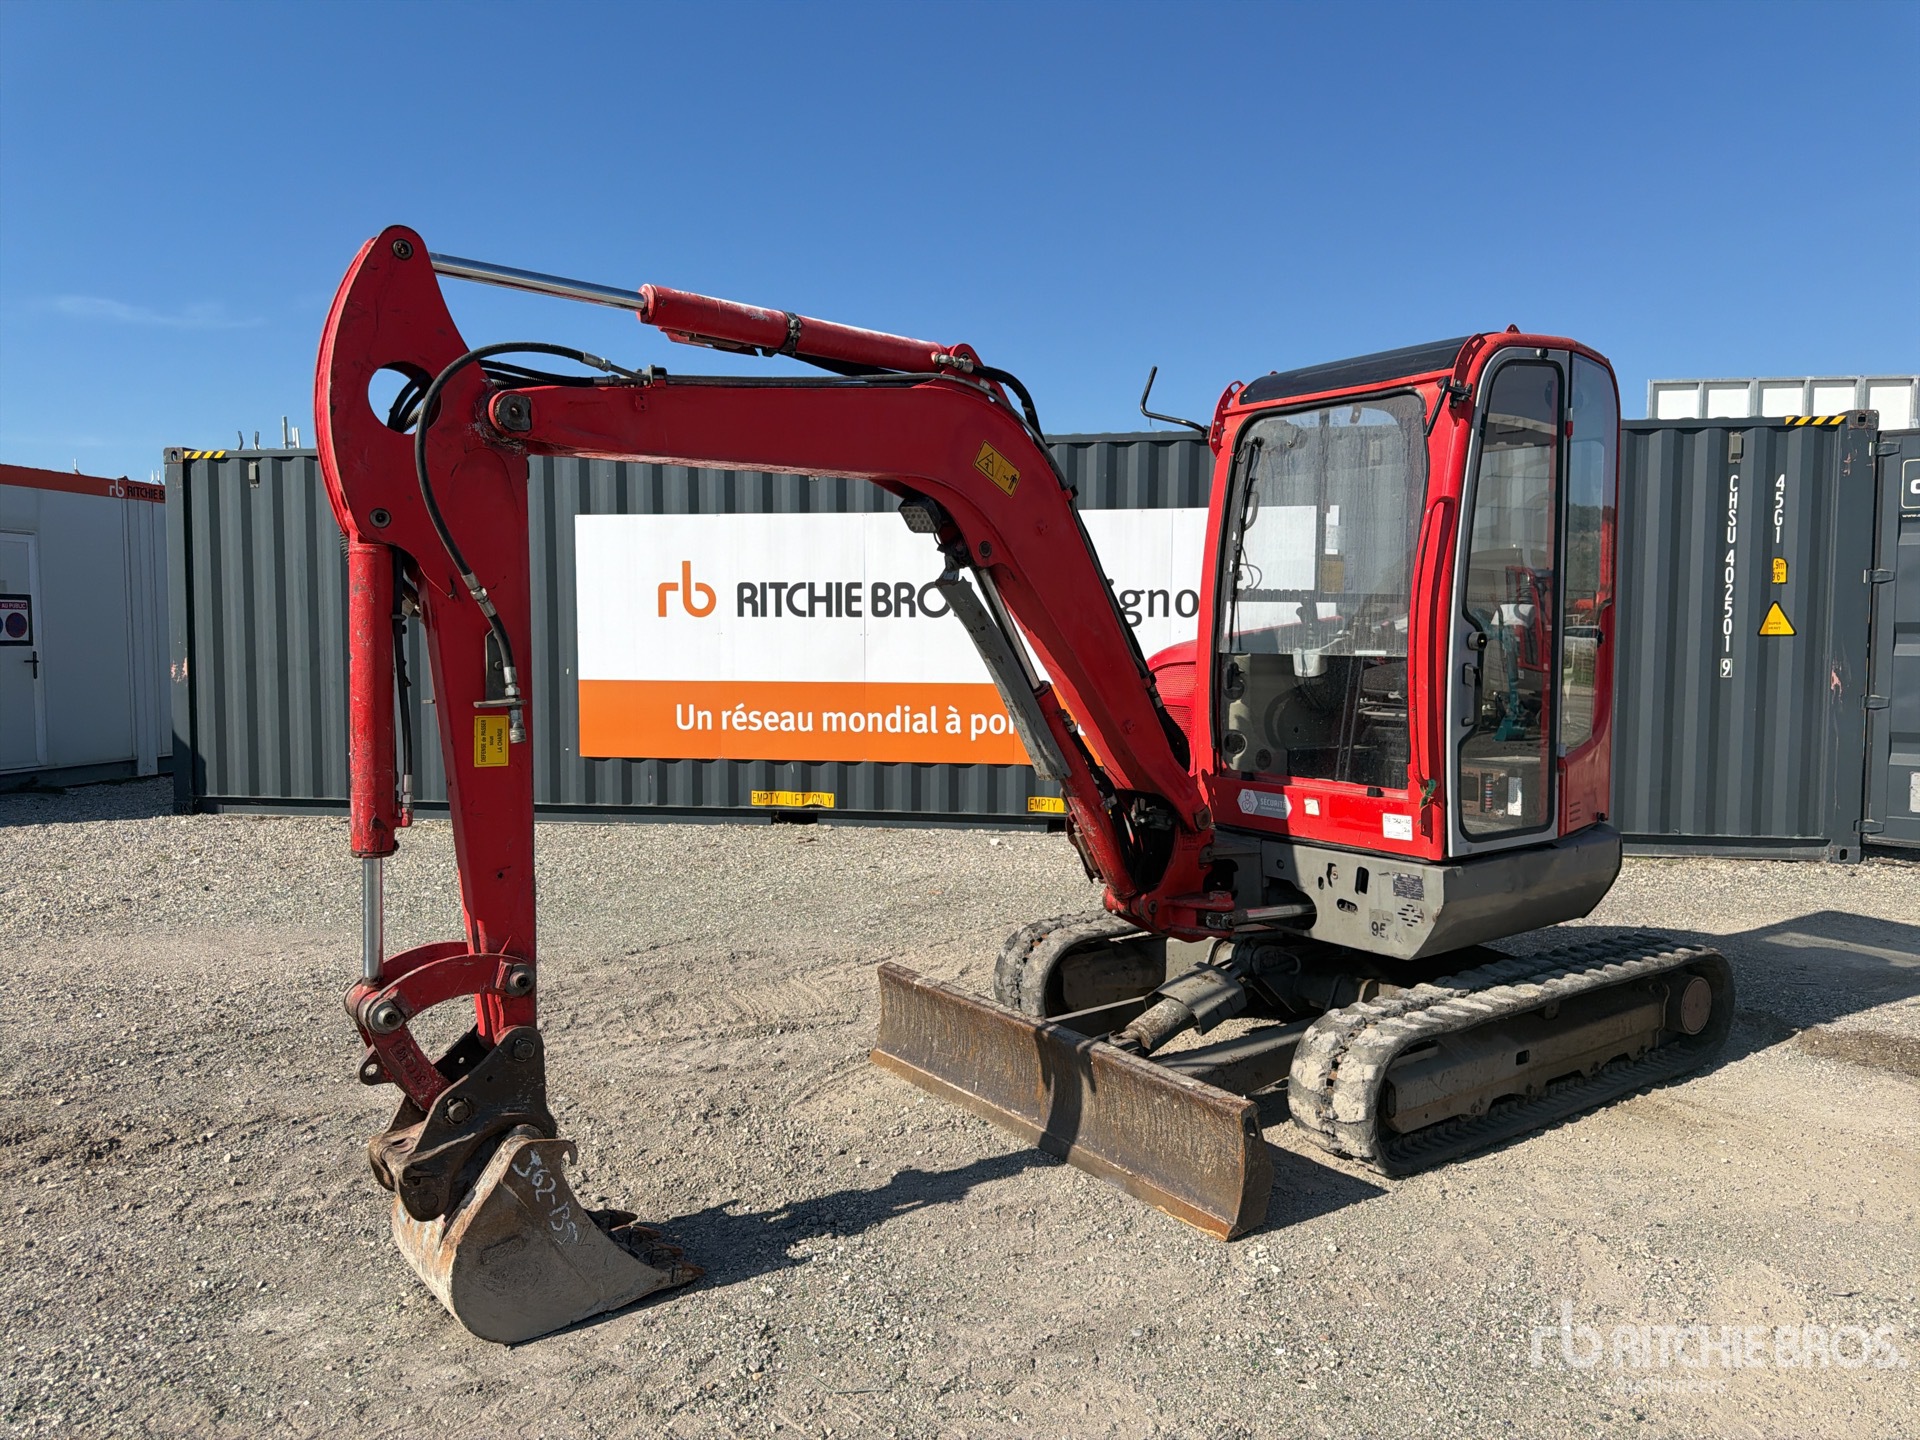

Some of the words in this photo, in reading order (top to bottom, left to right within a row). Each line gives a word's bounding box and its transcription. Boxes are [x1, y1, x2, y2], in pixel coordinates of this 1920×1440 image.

[127, 485, 158, 500] RITCHIE
[1727, 474, 1739, 543] CHSU
[1774, 474, 1785, 543] 45G1
[657, 560, 717, 618] rb
[736, 581, 863, 618] RITCHIE
[871, 581, 973, 618] BRO
[1107, 578, 1200, 628] gno
[1723, 549, 1735, 652] 402501
[1721, 659, 1732, 676] 9
[676, 703, 712, 731] Un
[721, 704, 814, 732] réseau
[822, 705, 938, 734] mondial
[945, 705, 962, 735] à
[752, 791, 780, 805] EMPTY
[784, 792, 806, 806] LIFT
[811, 793, 833, 807] ONLY
[1028, 797, 1057, 811] EMPTY
